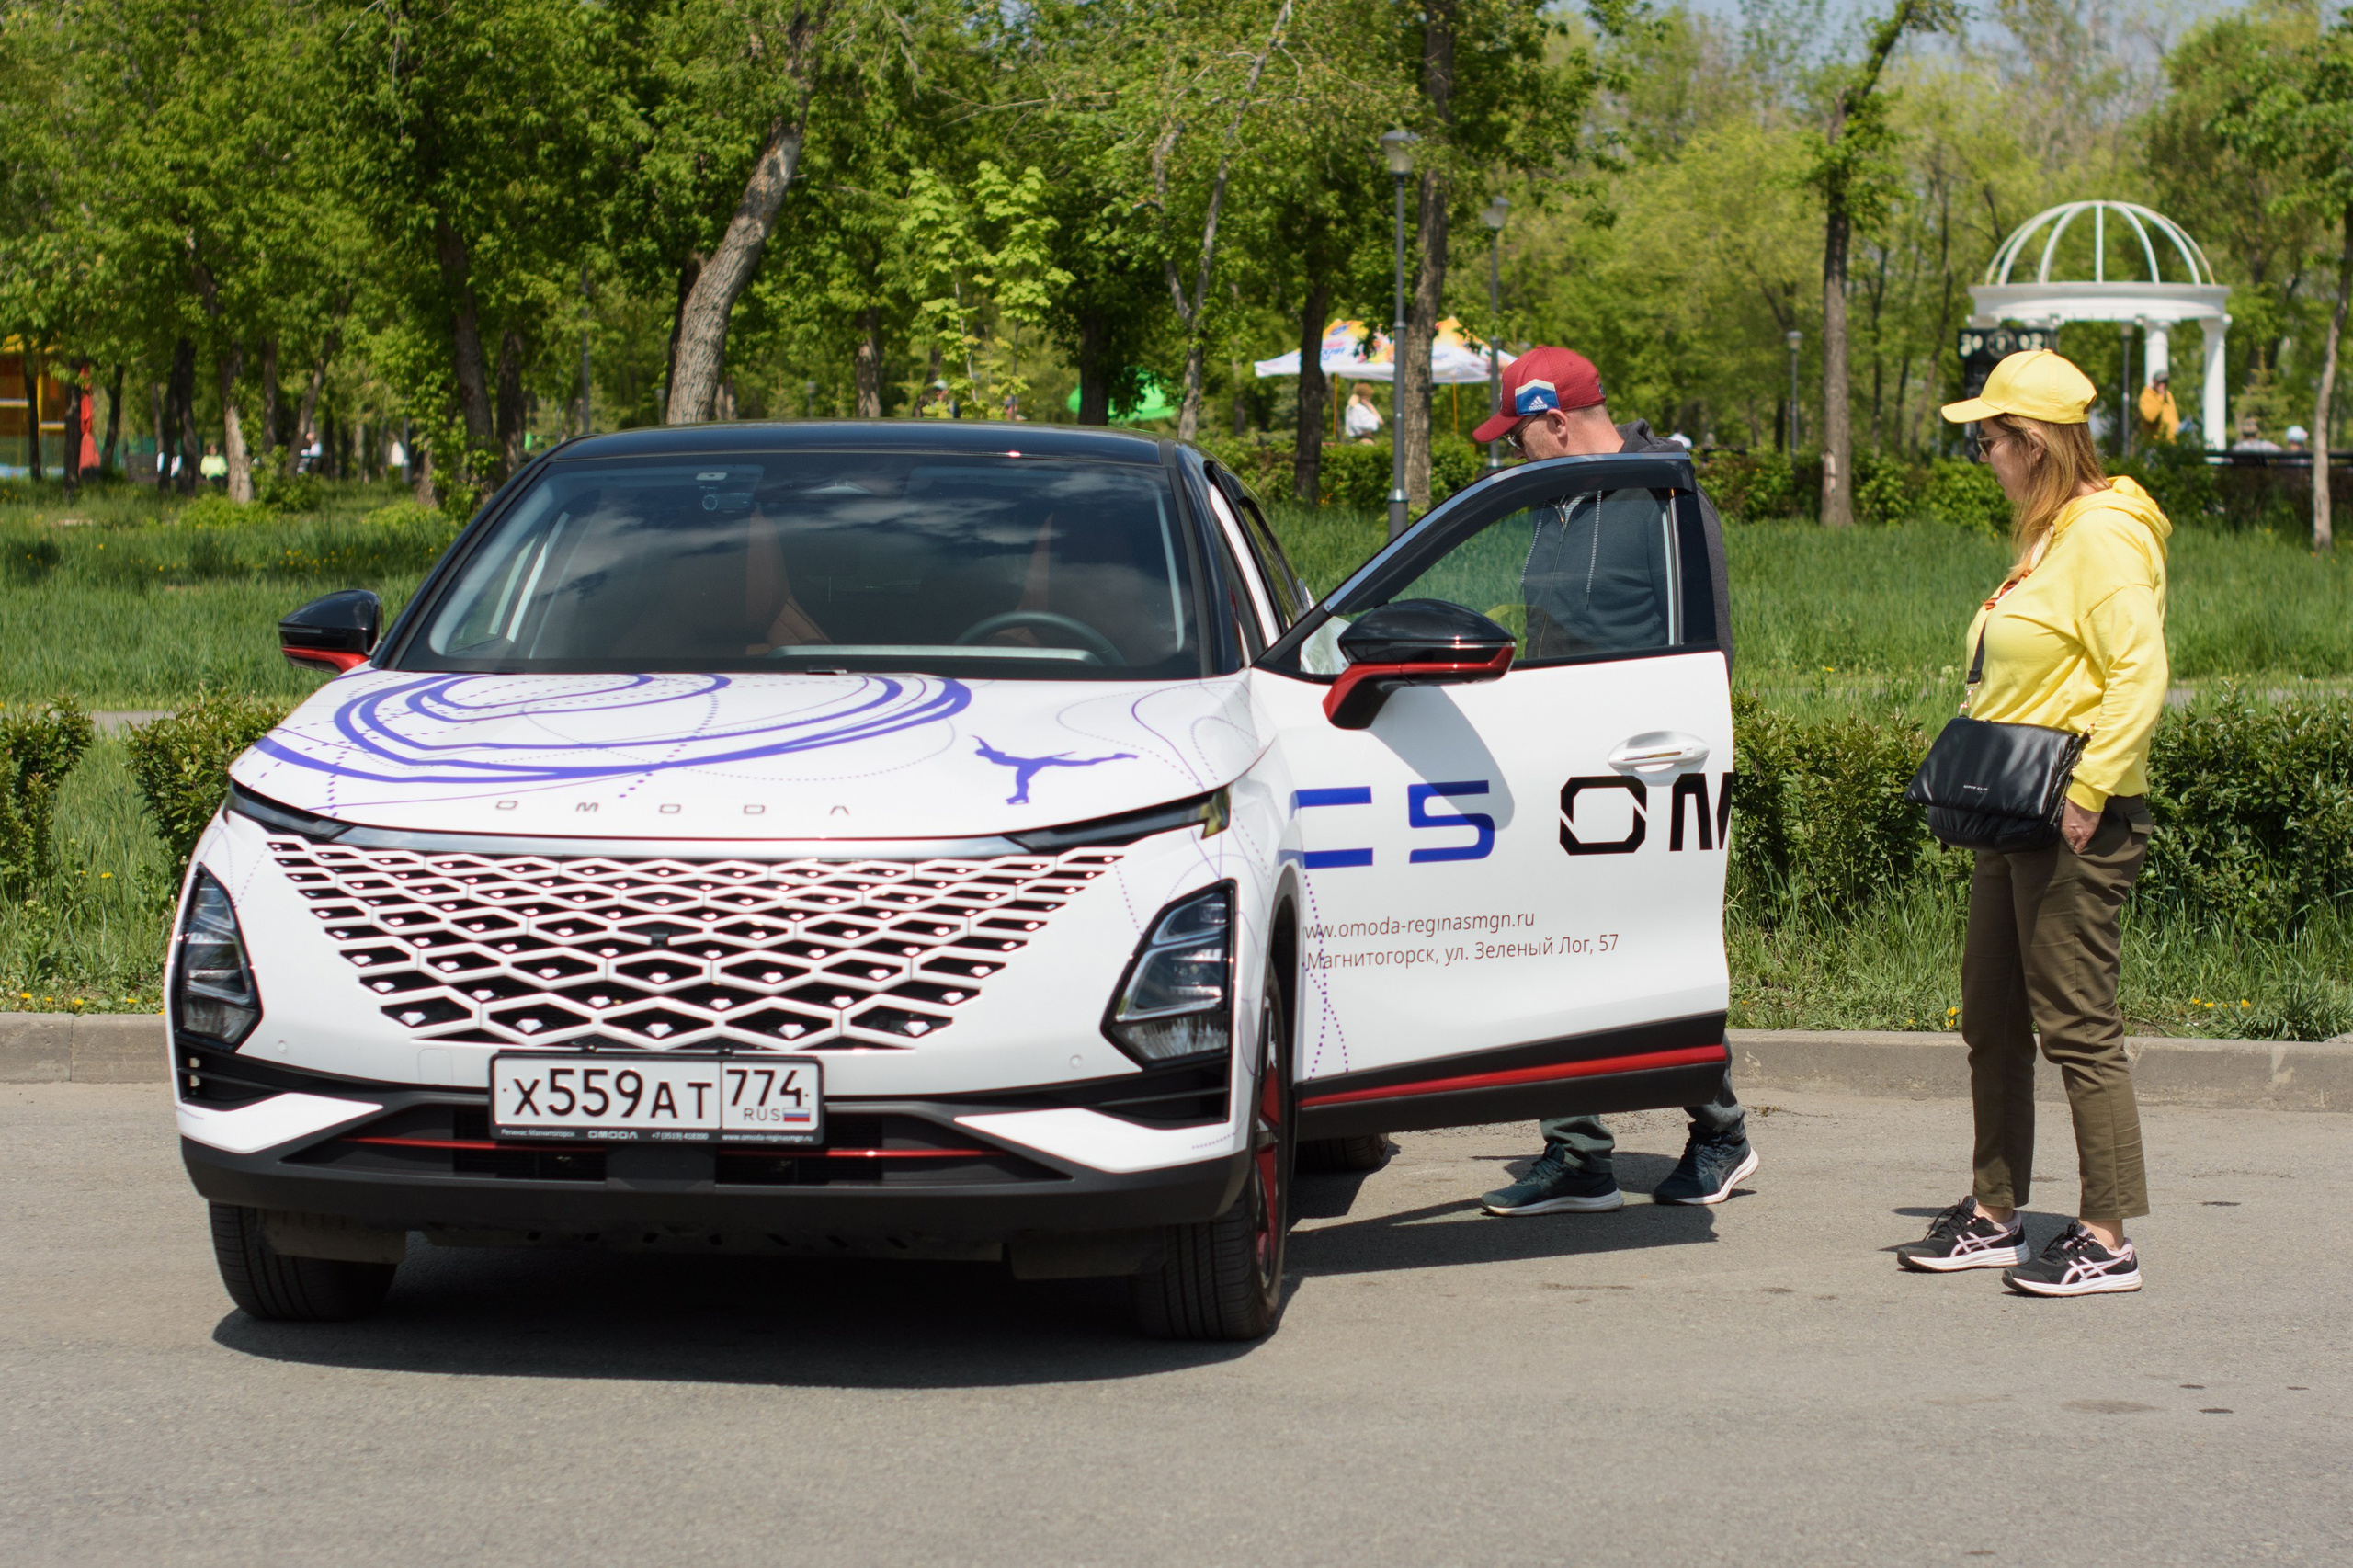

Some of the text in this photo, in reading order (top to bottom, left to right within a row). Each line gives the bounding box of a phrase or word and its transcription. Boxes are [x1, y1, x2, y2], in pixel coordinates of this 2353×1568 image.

[1308, 933, 1620, 969] Магнитогорск, ул. Зеленый Лог, 57
[726, 1068, 802, 1107] 774
[744, 1108, 780, 1121] RUS
